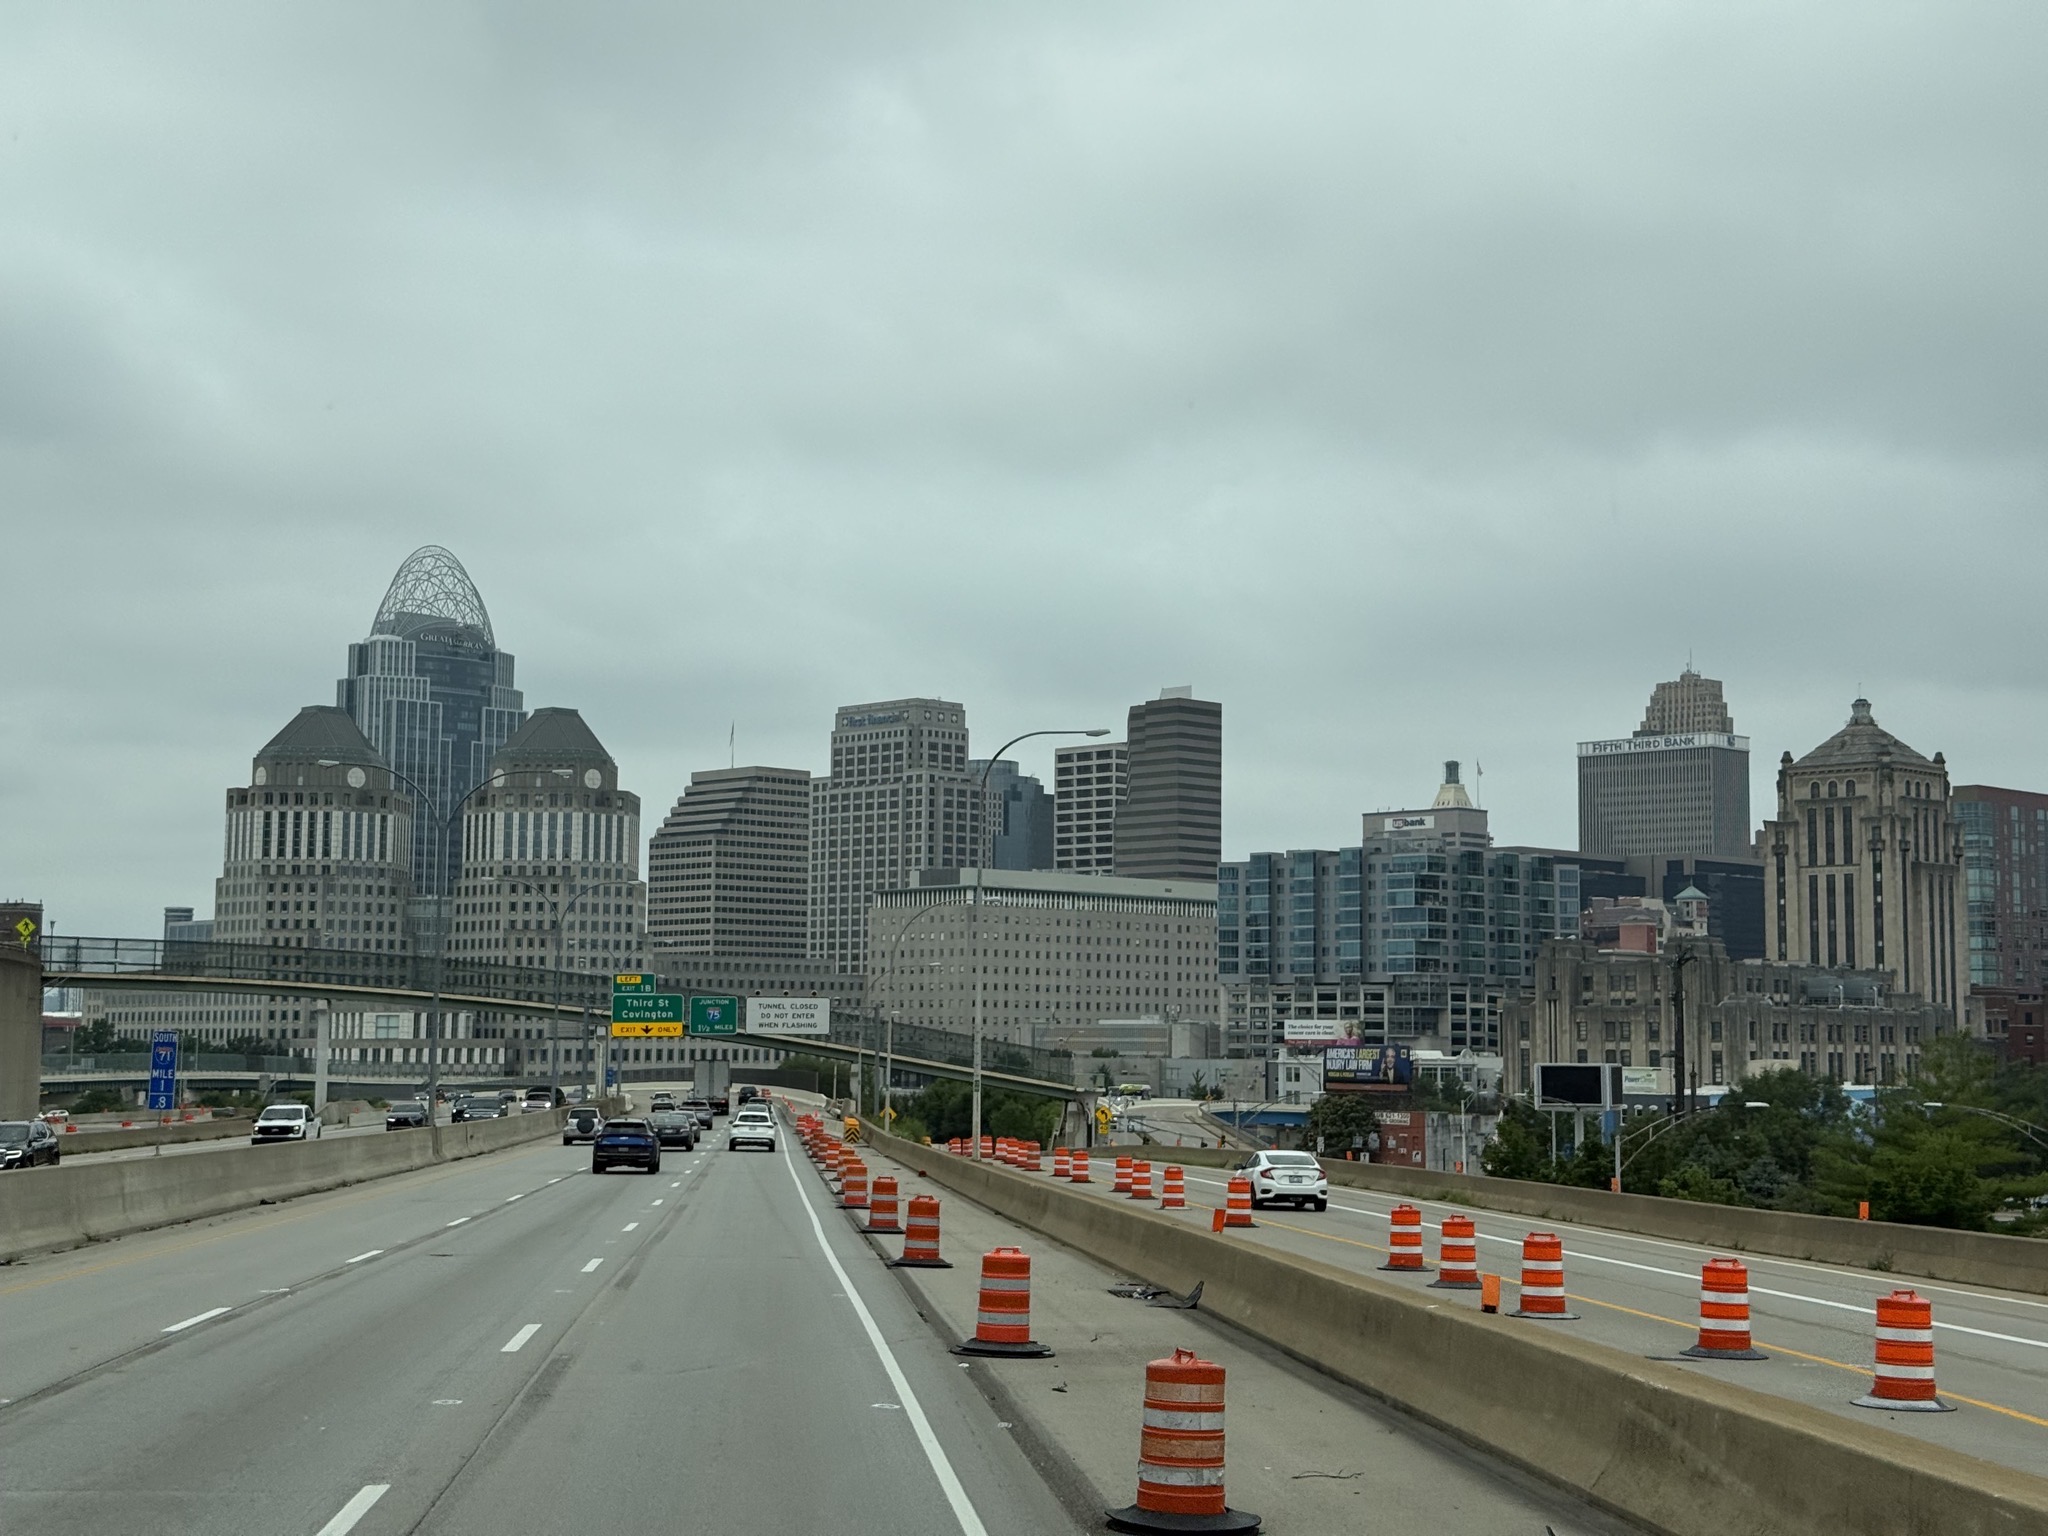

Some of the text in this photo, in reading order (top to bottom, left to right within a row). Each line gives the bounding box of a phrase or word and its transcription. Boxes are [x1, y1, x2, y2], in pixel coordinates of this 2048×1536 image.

[640, 984, 652, 992] 1B
[626, 999, 669, 1007] Third St
[622, 1010, 674, 1020] Covington
[708, 1010, 720, 1020] 75
[154, 1032, 177, 1042] SOUTH
[158, 1050, 171, 1061] 71
[152, 1069, 174, 1079] MILE
[160, 1079, 165, 1092] 1
